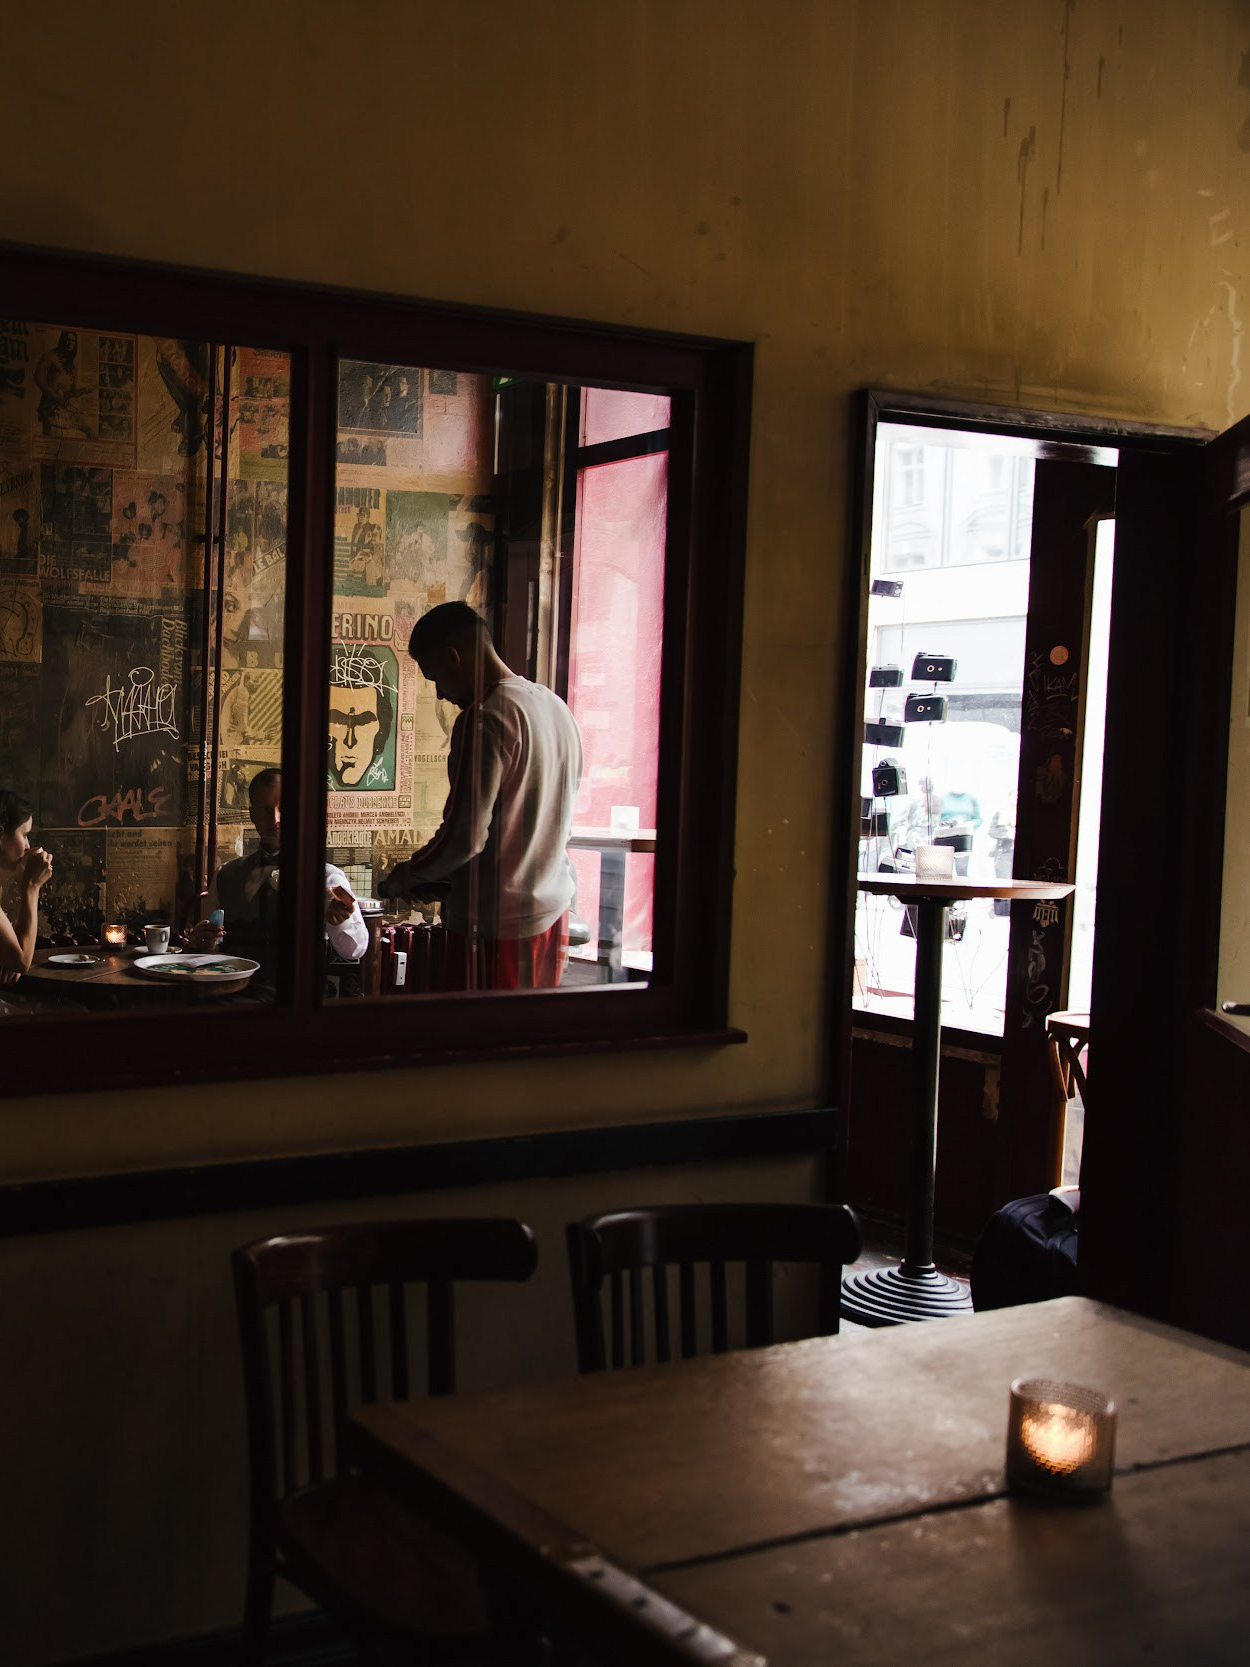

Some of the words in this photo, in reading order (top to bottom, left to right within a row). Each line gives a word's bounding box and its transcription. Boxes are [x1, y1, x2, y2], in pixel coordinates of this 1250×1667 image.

[39, 555, 57, 567] DIE
[38, 568, 111, 582] WOLFSFALLE
[174, 619, 188, 653] Blick
